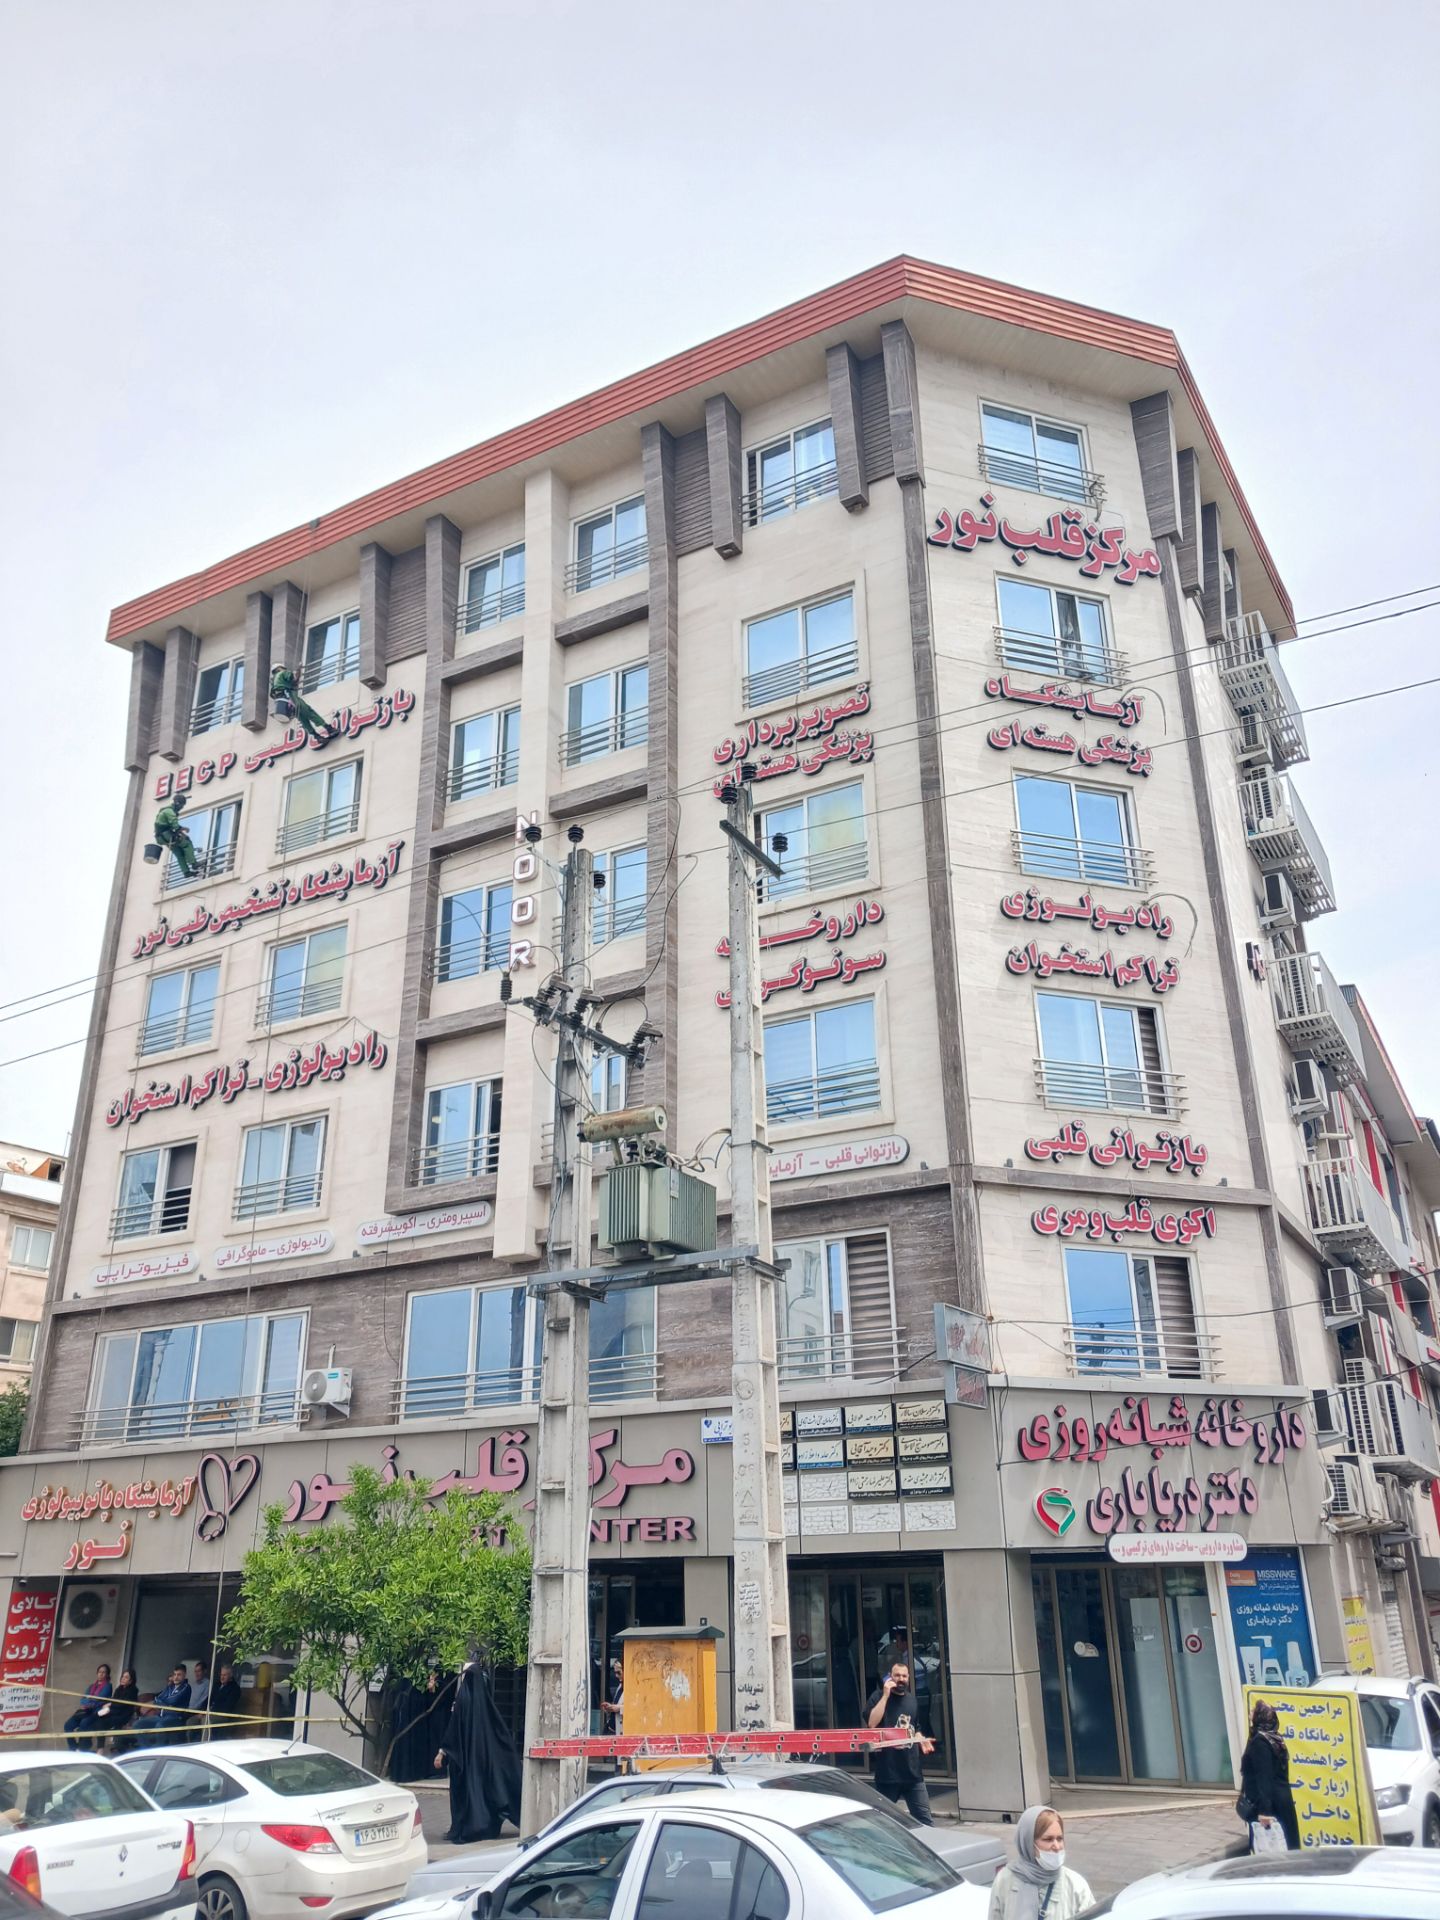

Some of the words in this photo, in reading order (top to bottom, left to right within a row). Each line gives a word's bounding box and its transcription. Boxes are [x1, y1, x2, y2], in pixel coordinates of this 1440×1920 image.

[928, 491, 997, 553] نور
[999, 508, 1087, 566] قلب
[1080, 522, 1162, 584] مرکز
[984, 674, 1144, 727] آزمایشگاه
[750, 752, 796, 783] هست
[801, 729, 874, 775] پزشکی
[1078, 734, 1154, 777] پزشکی
[154, 751, 236, 800] EECP
[287, 840, 404, 907] آزمایشگاه
[510, 810, 538, 971] NOOR
[166, 905, 212, 947] طبی
[209, 879, 288, 934] تشخیص
[1000, 886, 1175, 939] رادیولوژی
[132, 916, 168, 958] نور
[714, 899, 884, 958] داروخه
[714, 947, 887, 1009] سونوگری
[1005, 939, 1113, 979] استخوان
[1113, 954, 1180, 993] تراکم
[263, 1030, 387, 1093] رادیولوژی
[106, 1075, 192, 1129] استخوان
[190, 1057, 249, 1111] تراکم
[826, 1147, 852, 1170] قلبی
[855, 1141, 901, 1166] بازتوانی
[1024, 1119, 1089, 1163] قلبی
[1089, 1126, 1208, 1176] بازتوانی
[427, 1205, 487, 1230] اسپیرومتری
[1031, 1203, 1089, 1237] مری
[1087, 1208, 1105, 1239] و
[1104, 1199, 1154, 1243] قلب
[1152, 1207, 1216, 1245] اکوی
[216, 1242, 268, 1266] ماموگرافی
[276, 1234, 328, 1258] رادیولوژی
[95, 1252, 190, 1283] فیزیوتراپی
[1018, 1404, 1107, 1462] روزی
[1107, 1397, 1192, 1461] شبانه
[1196, 1399, 1306, 1464] داروخانه
[21, 1479, 114, 1522] پاتوبیولوژی
[115, 1475, 198, 1518] آزمایشگاه
[1201, 1466, 1259, 1532] دکتر
[62, 1520, 132, 1570] نور
[8, 1617, 52, 1634] پزشکی
[10, 1596, 56, 1614] کالای
[1236, 1604, 1253, 1615] روزی
[1253, 1603, 1271, 1614] شبانه
[1272, 1603, 1299, 1614] داروخانه
[1278, 1614, 1292, 1626] دکتر
[6, 1637, 49, 1660] آرون
[1299, 1702, 1342, 1719] مراجعین
[1298, 1727, 1344, 1746] درمانگاه
[1292, 1752, 1347, 1771] خواهشمند
[1309, 1777, 1338, 1797] پارک
[1302, 1804, 1350, 1820] داخل
